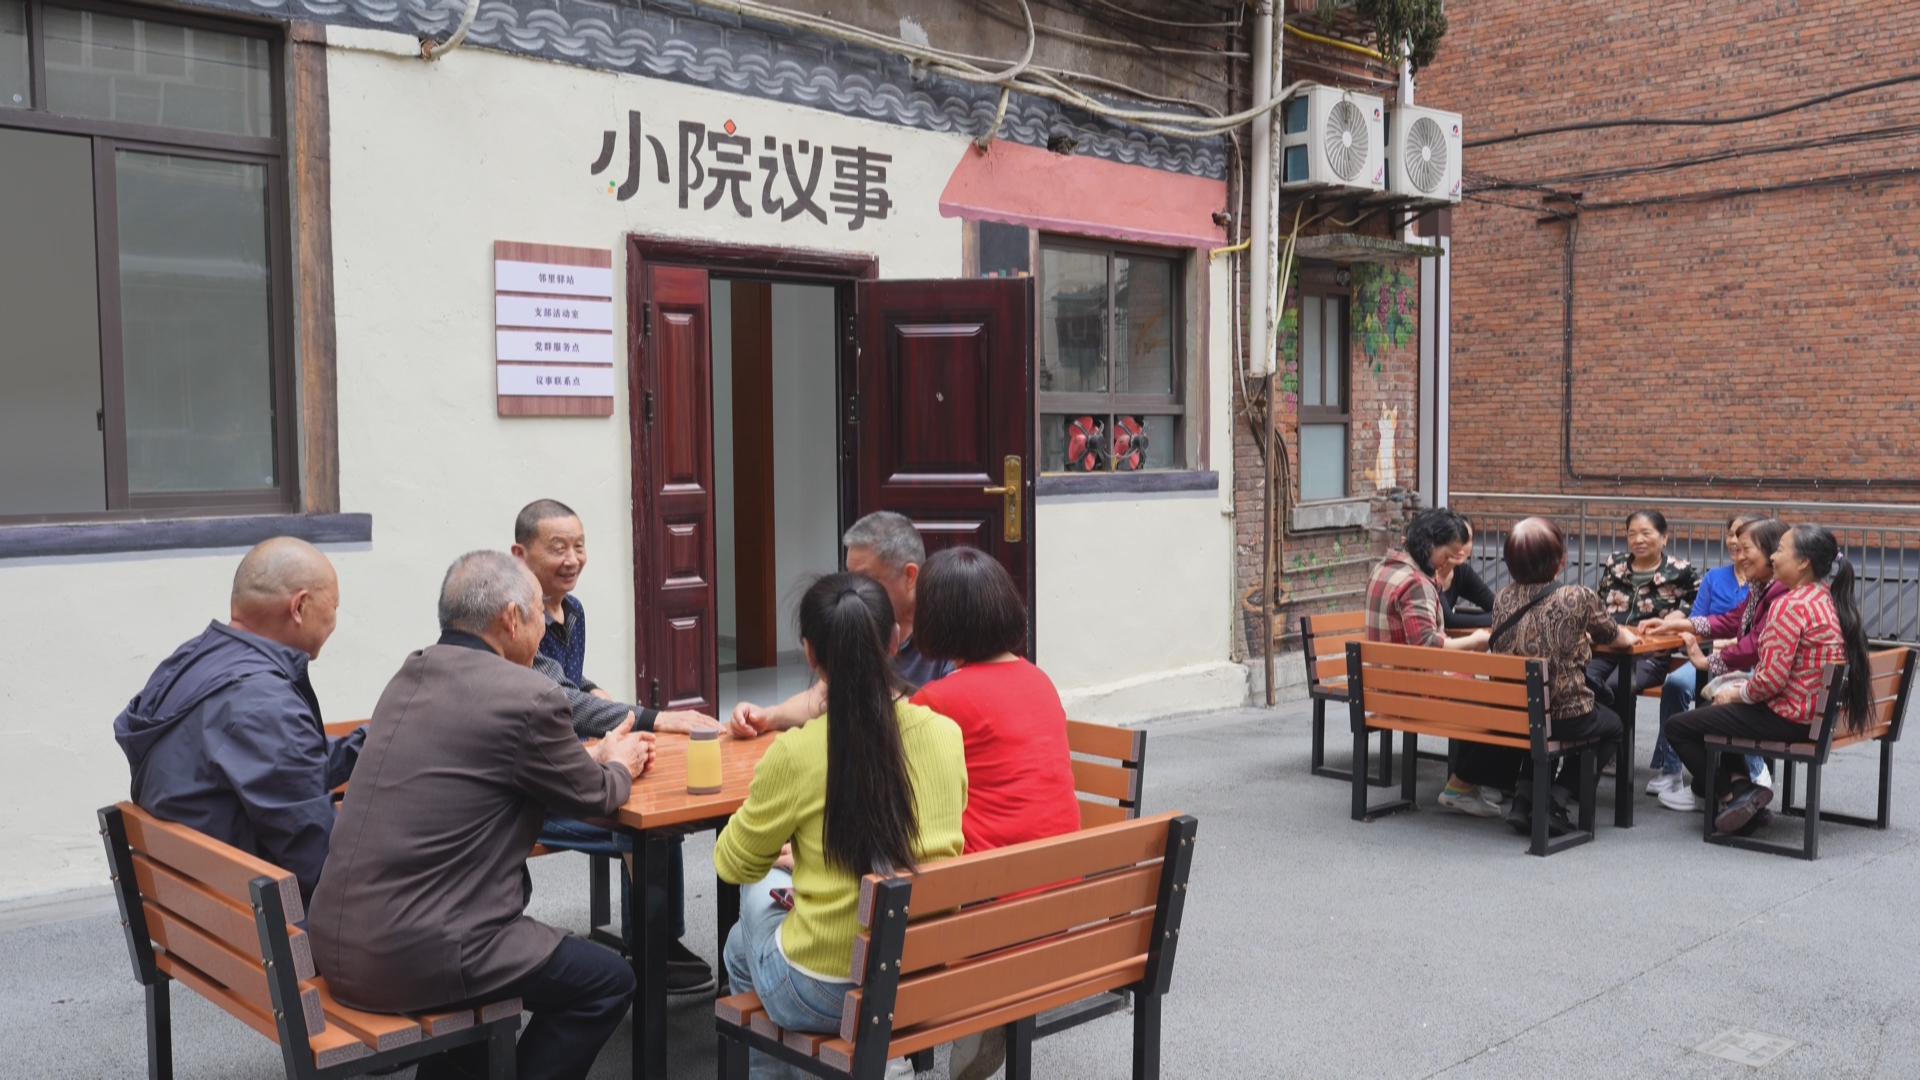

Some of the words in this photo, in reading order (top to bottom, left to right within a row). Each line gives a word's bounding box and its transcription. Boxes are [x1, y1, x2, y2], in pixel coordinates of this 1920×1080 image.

[591, 109, 893, 231] 小院议事
[538, 272, 574, 285] 邻里驿站
[535, 307, 579, 319] 支部活动室
[535, 341, 580, 353] 党群服务点
[536, 375, 581, 387] 议事联系点
